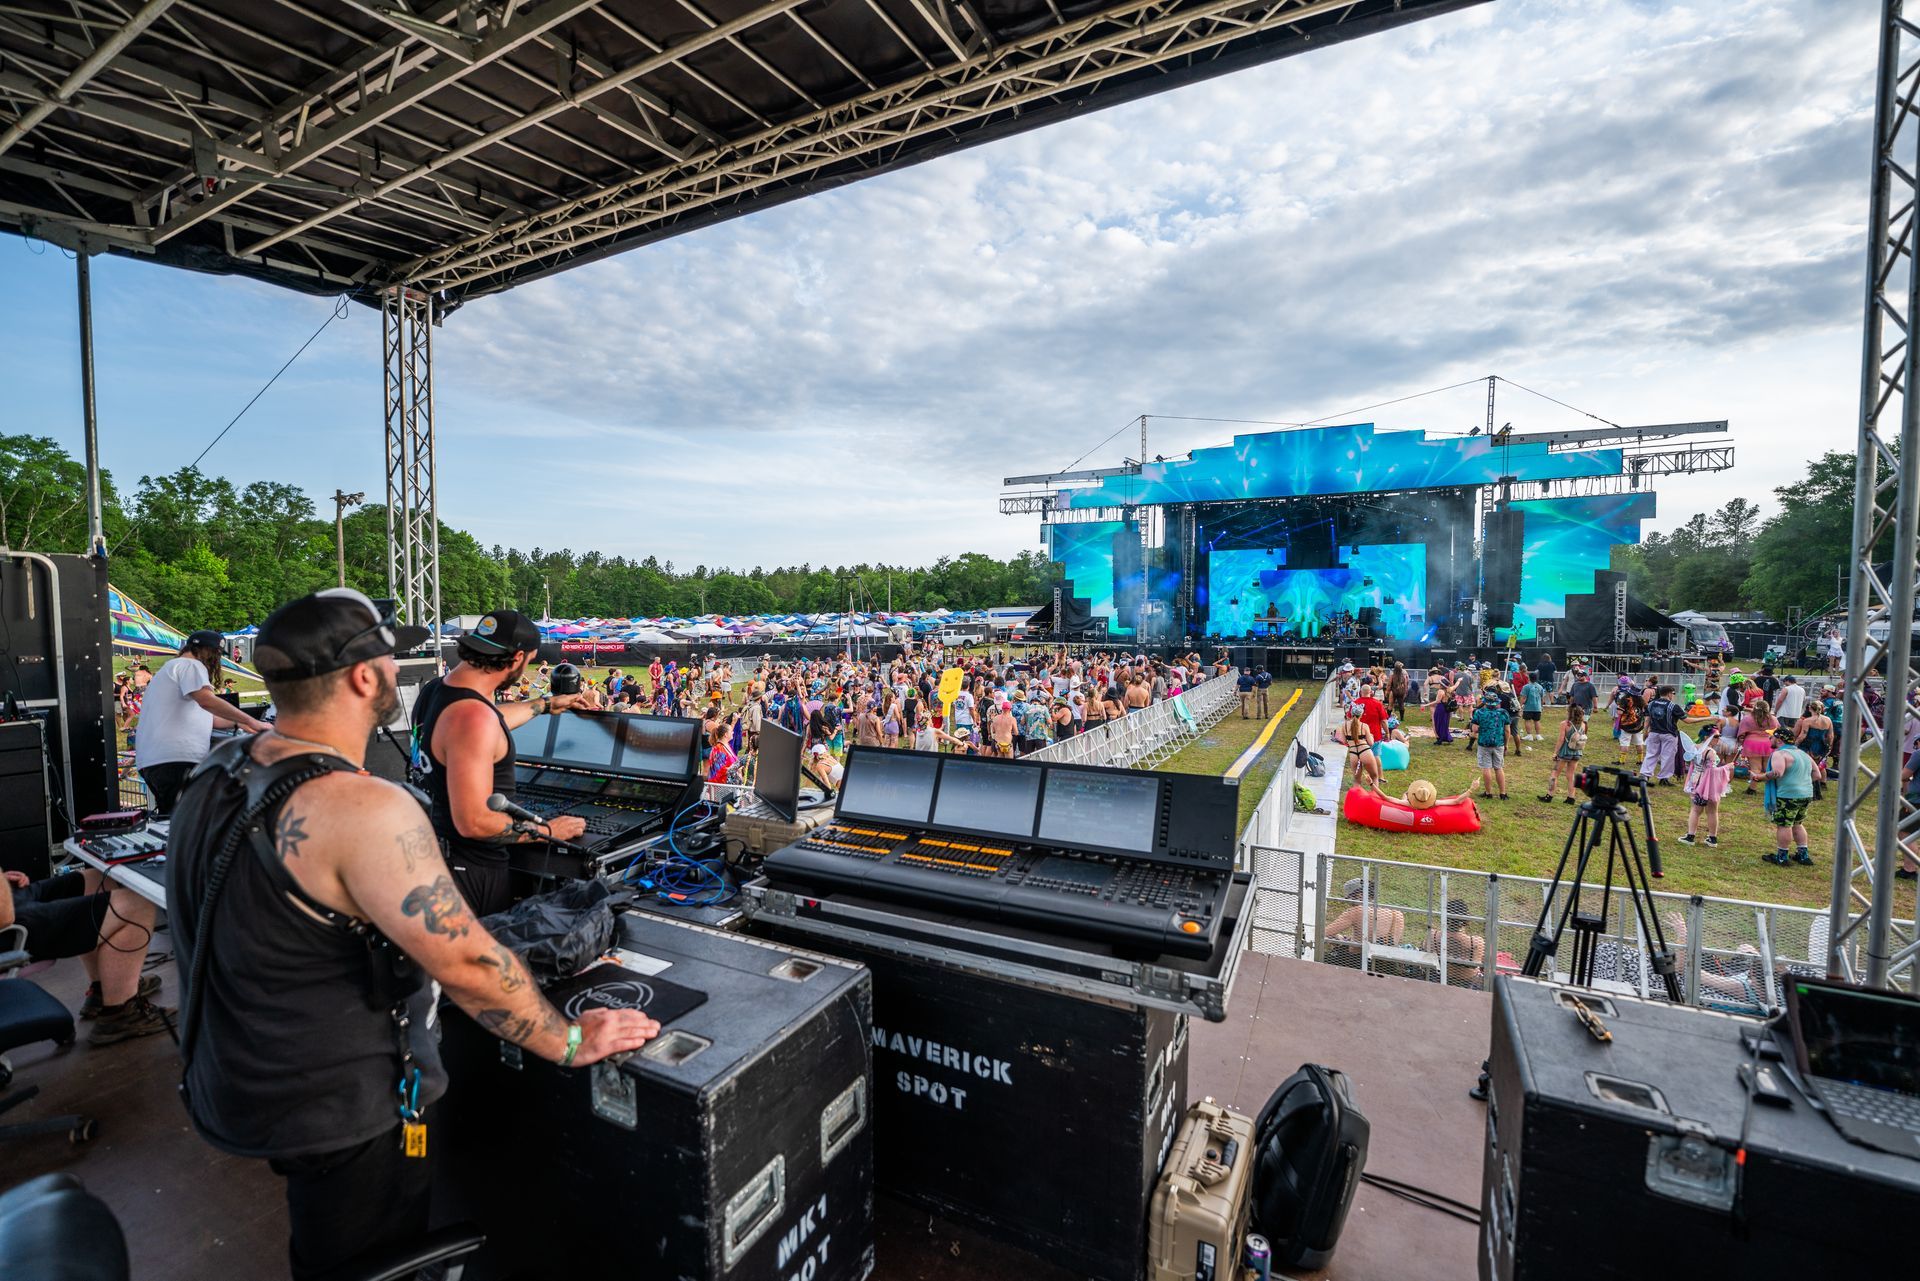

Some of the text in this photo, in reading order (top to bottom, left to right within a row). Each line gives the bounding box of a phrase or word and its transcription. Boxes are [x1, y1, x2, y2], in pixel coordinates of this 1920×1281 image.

[872, 1026, 1013, 1086] MAVERICK
[896, 1071, 967, 1111] SPOT
[778, 1193, 827, 1270] MK1
